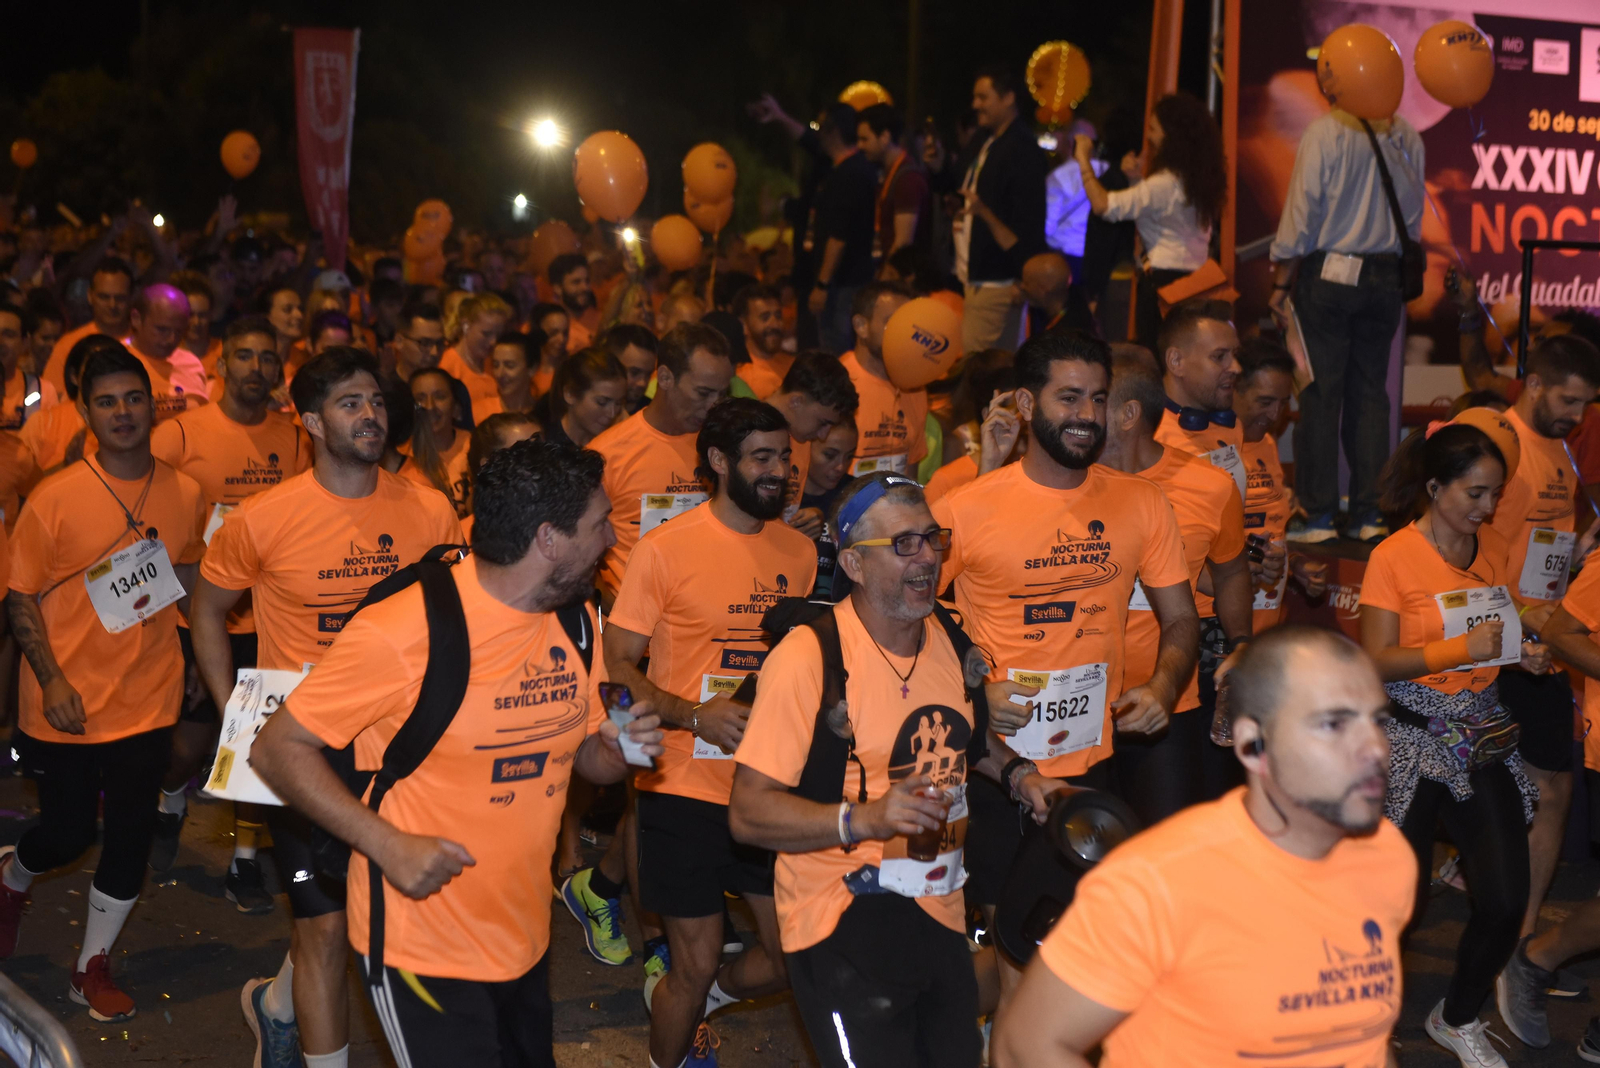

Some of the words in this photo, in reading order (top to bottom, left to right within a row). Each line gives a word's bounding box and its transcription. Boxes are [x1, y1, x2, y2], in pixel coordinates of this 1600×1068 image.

[1528, 108, 1551, 131] 30
[1552, 110, 1576, 133] de
[1471, 142, 1595, 195] XXXIV
[1471, 202, 1600, 258] NOC
[225, 477, 260, 485] SEVILLA
[1050, 541, 1111, 555] NOCTURNA
[343, 554, 400, 566] NOCTURNA
[1024, 555, 1078, 570] SEVILLA
[109, 562, 158, 598] 13410
[317, 567, 369, 580] SEVILLA
[520, 672, 578, 692] NOCTURNA
[494, 693, 549, 710] SEVILLA
[1033, 694, 1090, 722] 15622
[1319, 958, 1393, 984] NOCTURNA
[1278, 986, 1355, 1014] SEVILLA
